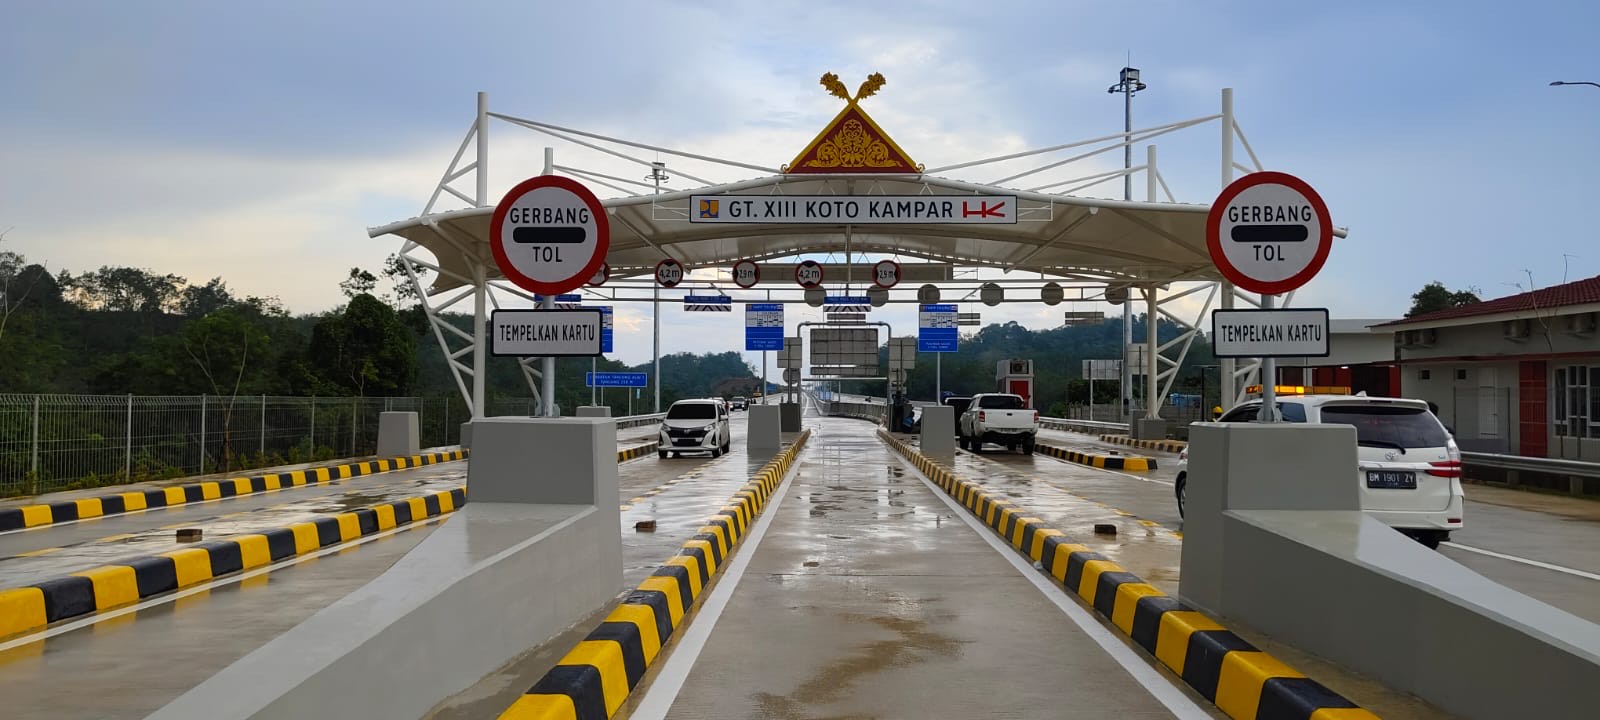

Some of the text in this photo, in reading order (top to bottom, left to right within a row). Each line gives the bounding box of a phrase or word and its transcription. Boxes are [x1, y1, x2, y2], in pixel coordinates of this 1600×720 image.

[509, 207, 589, 224] GERBANG
[729, 200, 757, 218] GT.
[764, 200, 796, 218] XIII
[806, 200, 859, 218] KOTO
[869, 200, 953, 218] KAMPAR
[1228, 205, 1312, 223] GERBANG
[532, 246, 563, 263] TOL
[1253, 244, 1285, 261] TOL
[500, 324, 595, 341] TEMPELKAN KARTU
[1222, 324, 1321, 342] TEMPELKAN KARTU
[1369, 472, 1414, 483] BM 1901 ZY
